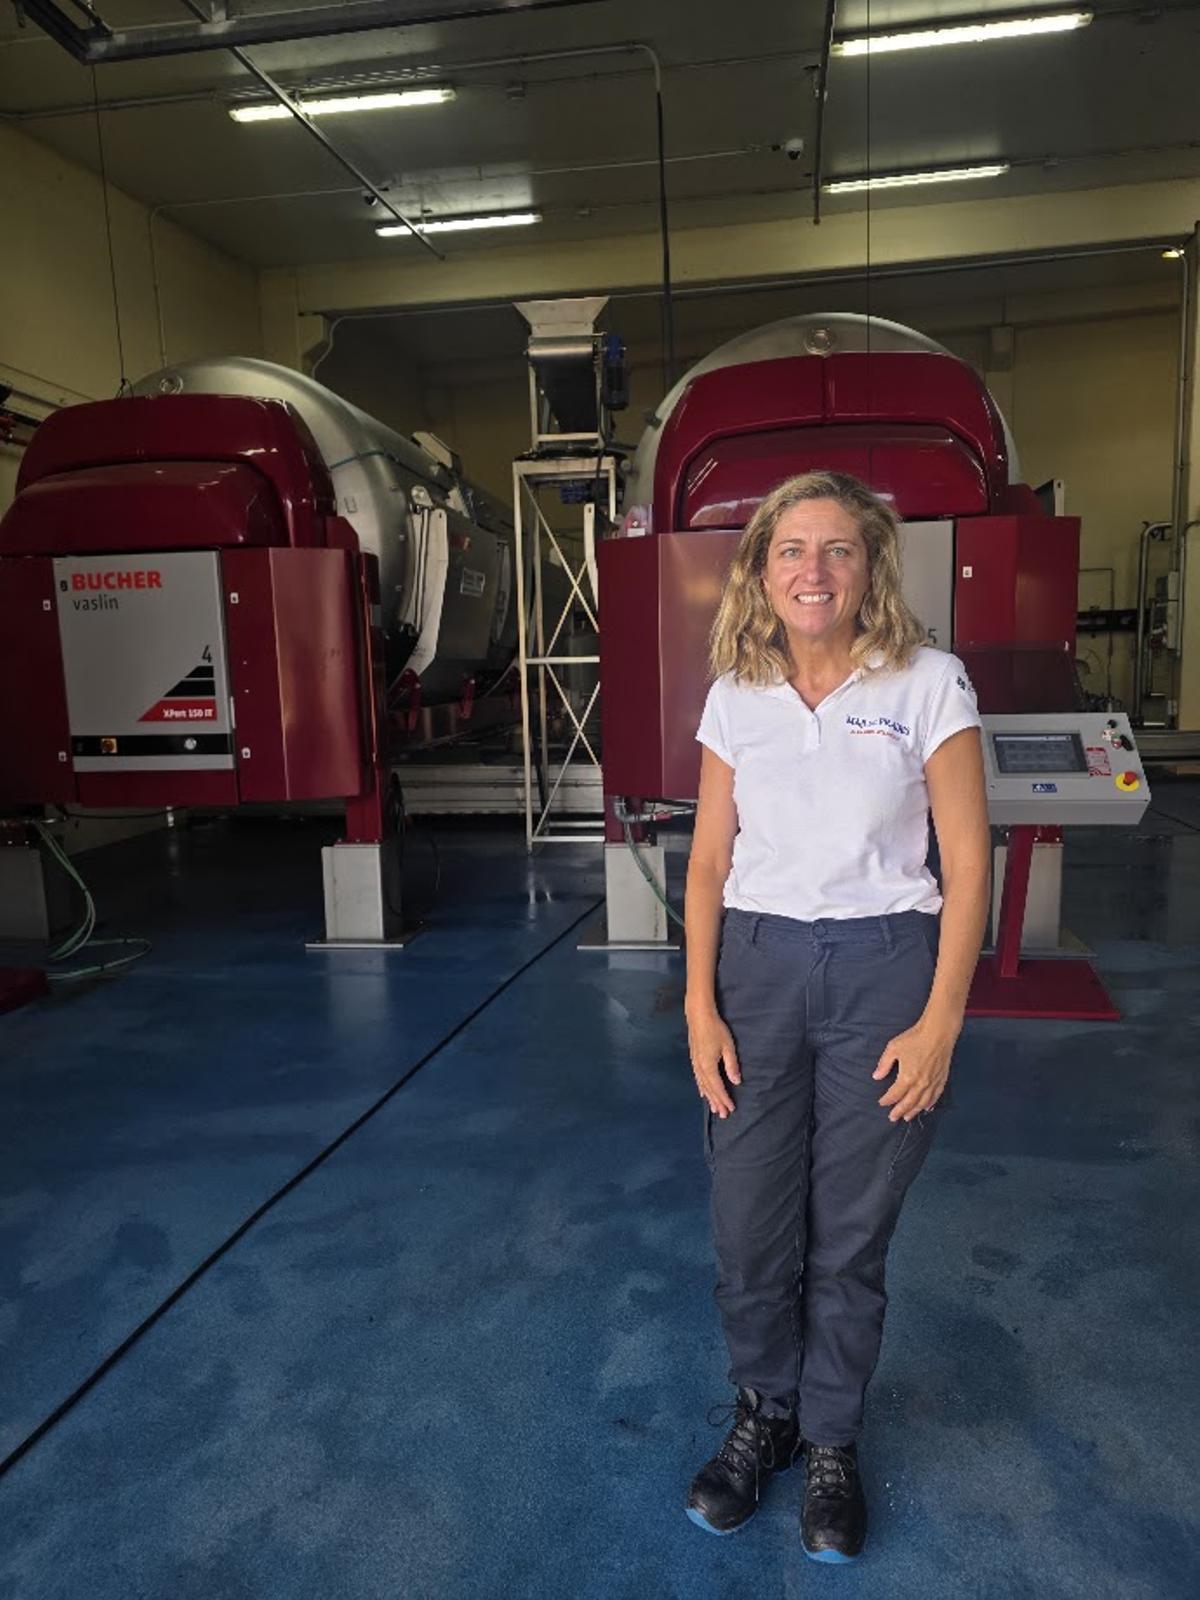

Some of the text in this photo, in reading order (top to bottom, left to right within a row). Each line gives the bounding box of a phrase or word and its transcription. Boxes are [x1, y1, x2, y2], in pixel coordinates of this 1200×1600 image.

[72, 571, 162, 591] BUCHER
[73, 594, 119, 611] vaslin
[928, 628, 937, 645] 5
[202, 645, 212, 663] 4
